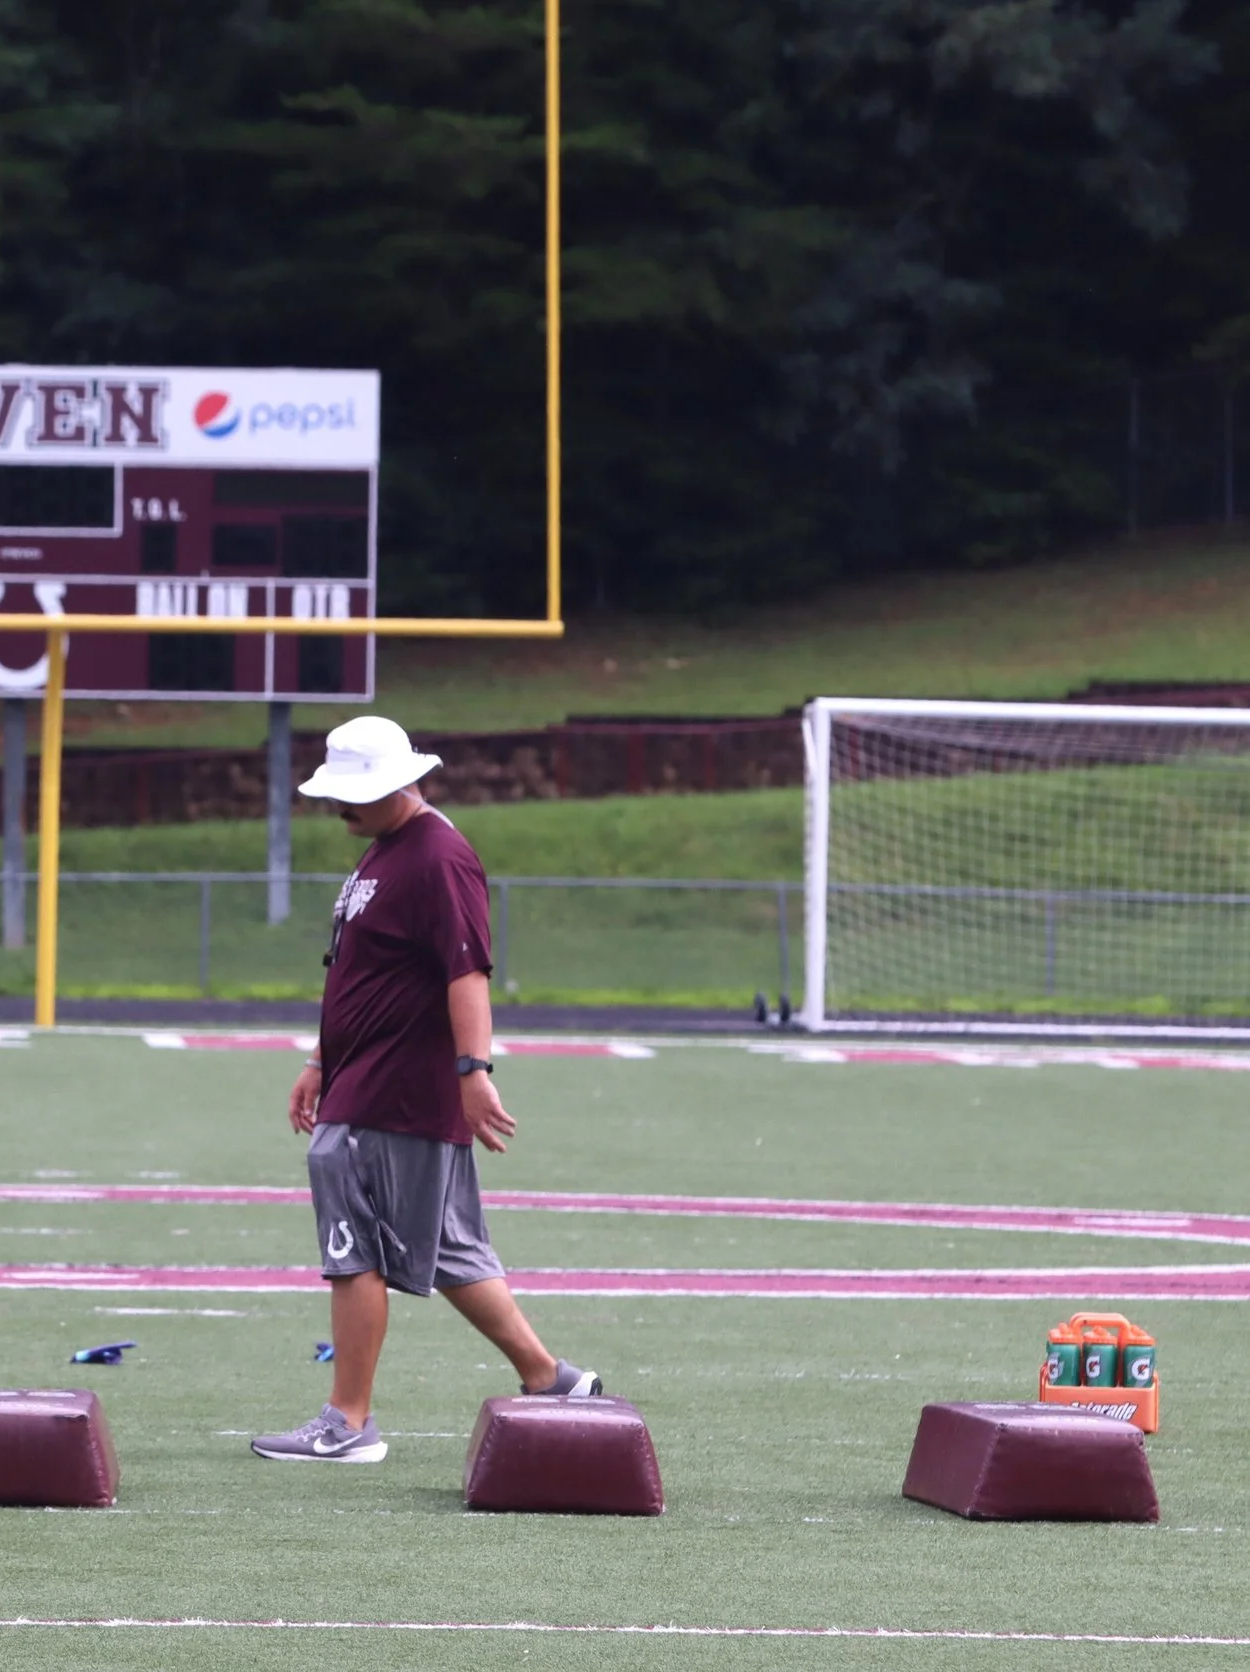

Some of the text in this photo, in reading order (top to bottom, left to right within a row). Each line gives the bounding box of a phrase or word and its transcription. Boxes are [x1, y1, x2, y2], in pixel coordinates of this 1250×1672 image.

[250, 398, 356, 435] pepsi
[1086, 1355, 1100, 1378] G
[1131, 1358, 1150, 1380] G
[1070, 1402, 1139, 1420] torade
